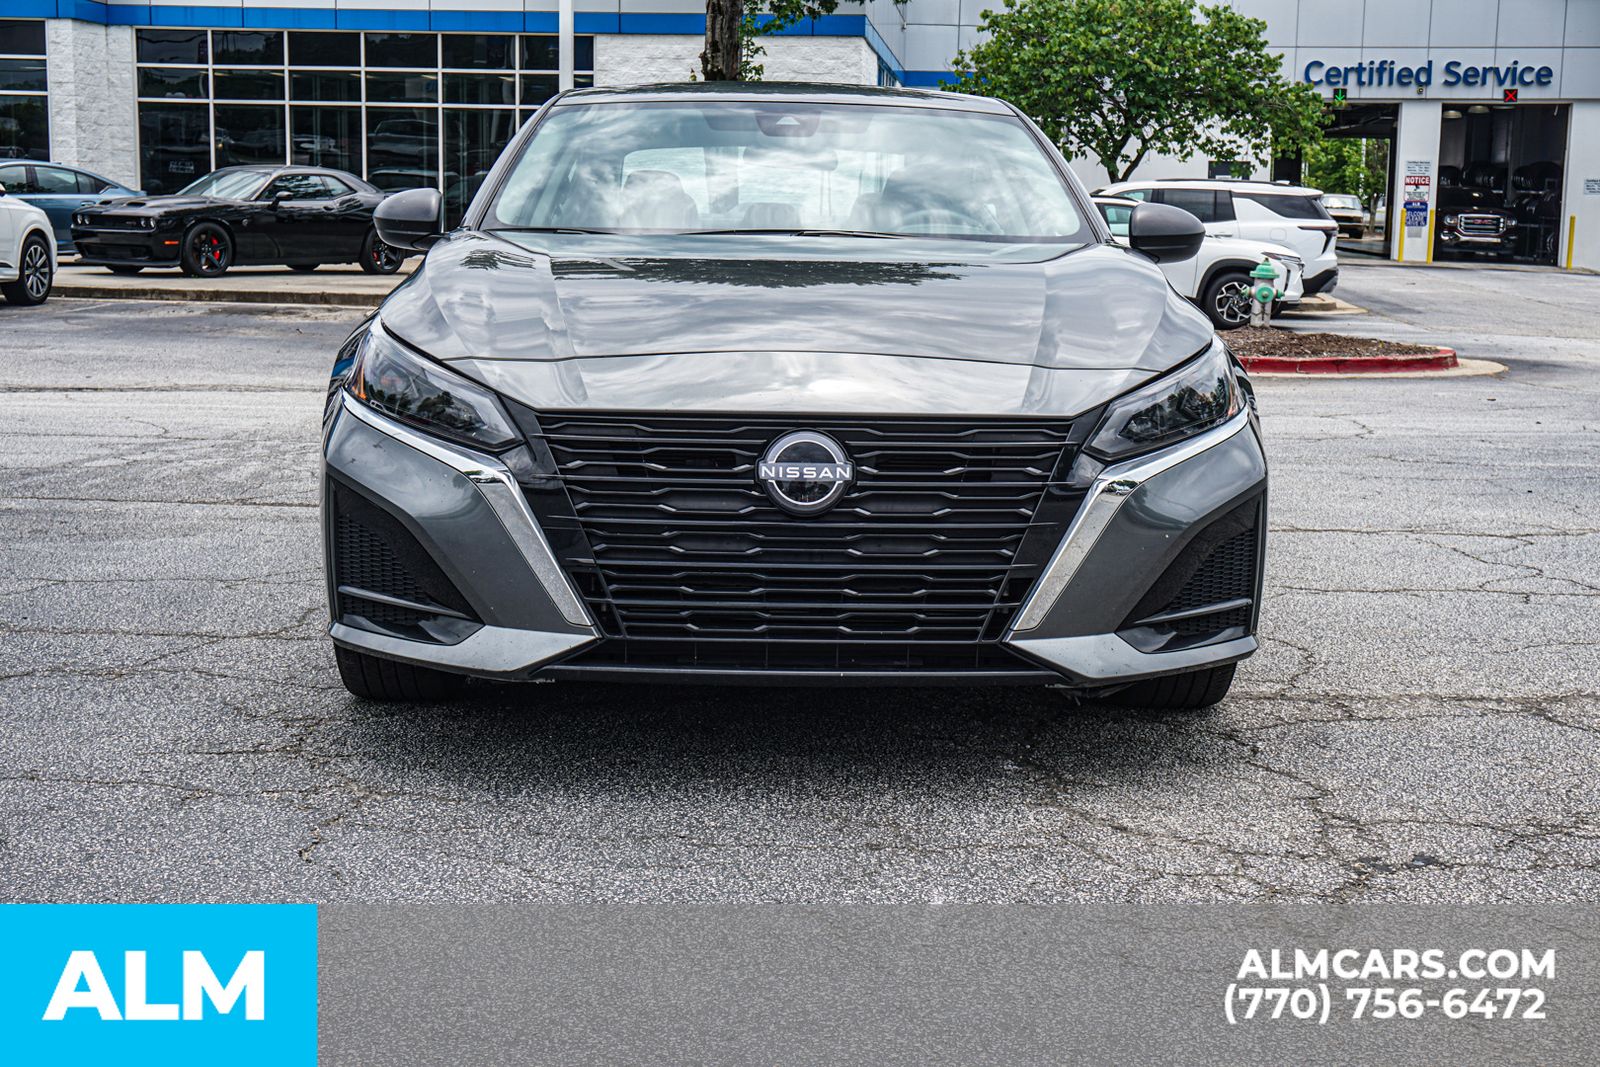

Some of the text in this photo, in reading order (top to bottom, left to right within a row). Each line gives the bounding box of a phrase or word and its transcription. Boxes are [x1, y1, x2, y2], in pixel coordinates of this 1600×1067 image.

[1304, 60, 1554, 87] Certified Service
[761, 465, 850, 479] NISSAN
